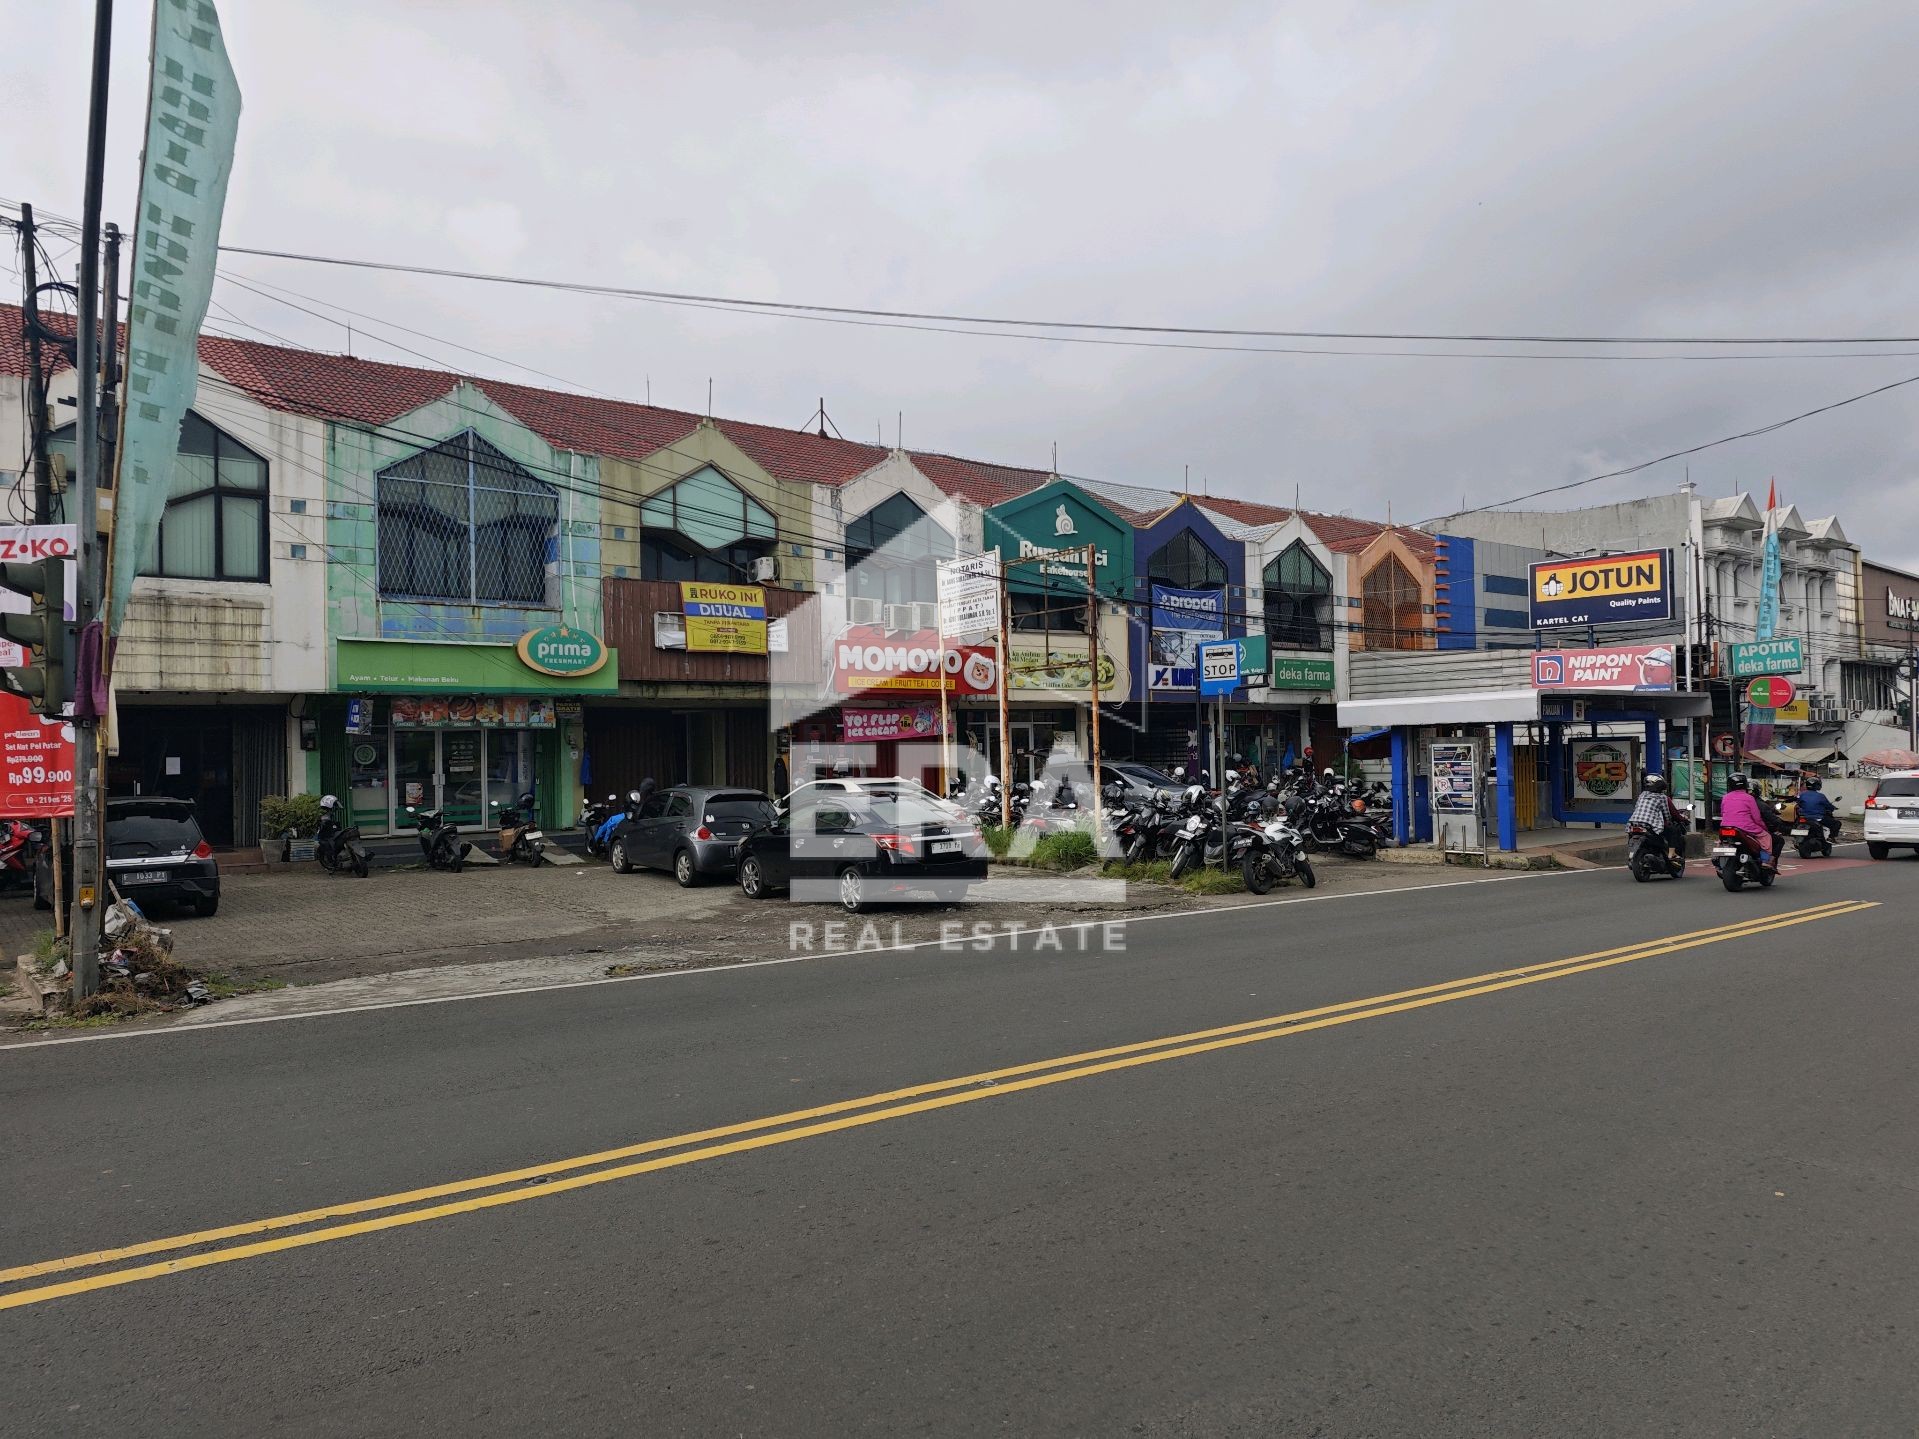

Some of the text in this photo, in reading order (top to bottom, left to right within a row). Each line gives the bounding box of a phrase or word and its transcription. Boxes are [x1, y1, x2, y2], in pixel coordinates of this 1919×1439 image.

[951, 560, 984, 575] NOTARIS
[1567, 564, 1654, 594] JOTUN
[700, 588, 758, 603] RUKO INI
[1609, 596, 1661, 608] Quality Paints
[700, 604, 751, 618] DIJUAL
[1536, 615, 1589, 626] KARTEL CAT
[537, 642, 592, 658] prima
[1738, 640, 1796, 657] APOTIK
[544, 657, 588, 665] FRESHMART
[838, 644, 962, 674] MOMOYO
[1568, 653, 1633, 669] NIPPON
[1738, 657, 1798, 673] deka farma
[1204, 663, 1236, 676] STOP
[1279, 667, 1302, 680] deka
[1304, 668, 1331, 681] farma
[1573, 667, 1622, 682] PAINT
[350, 674, 371, 683] Ayam
[408, 675, 440, 683] Makanan
[441, 676, 459, 684] Beku
[895, 679, 912, 687] FRUIT
[845, 713, 900, 726] YO! FLIP
[848, 725, 898, 738] ICE CREAM
[30, 742, 41, 750] Pel
[8, 766, 72, 786] Rp99.900
